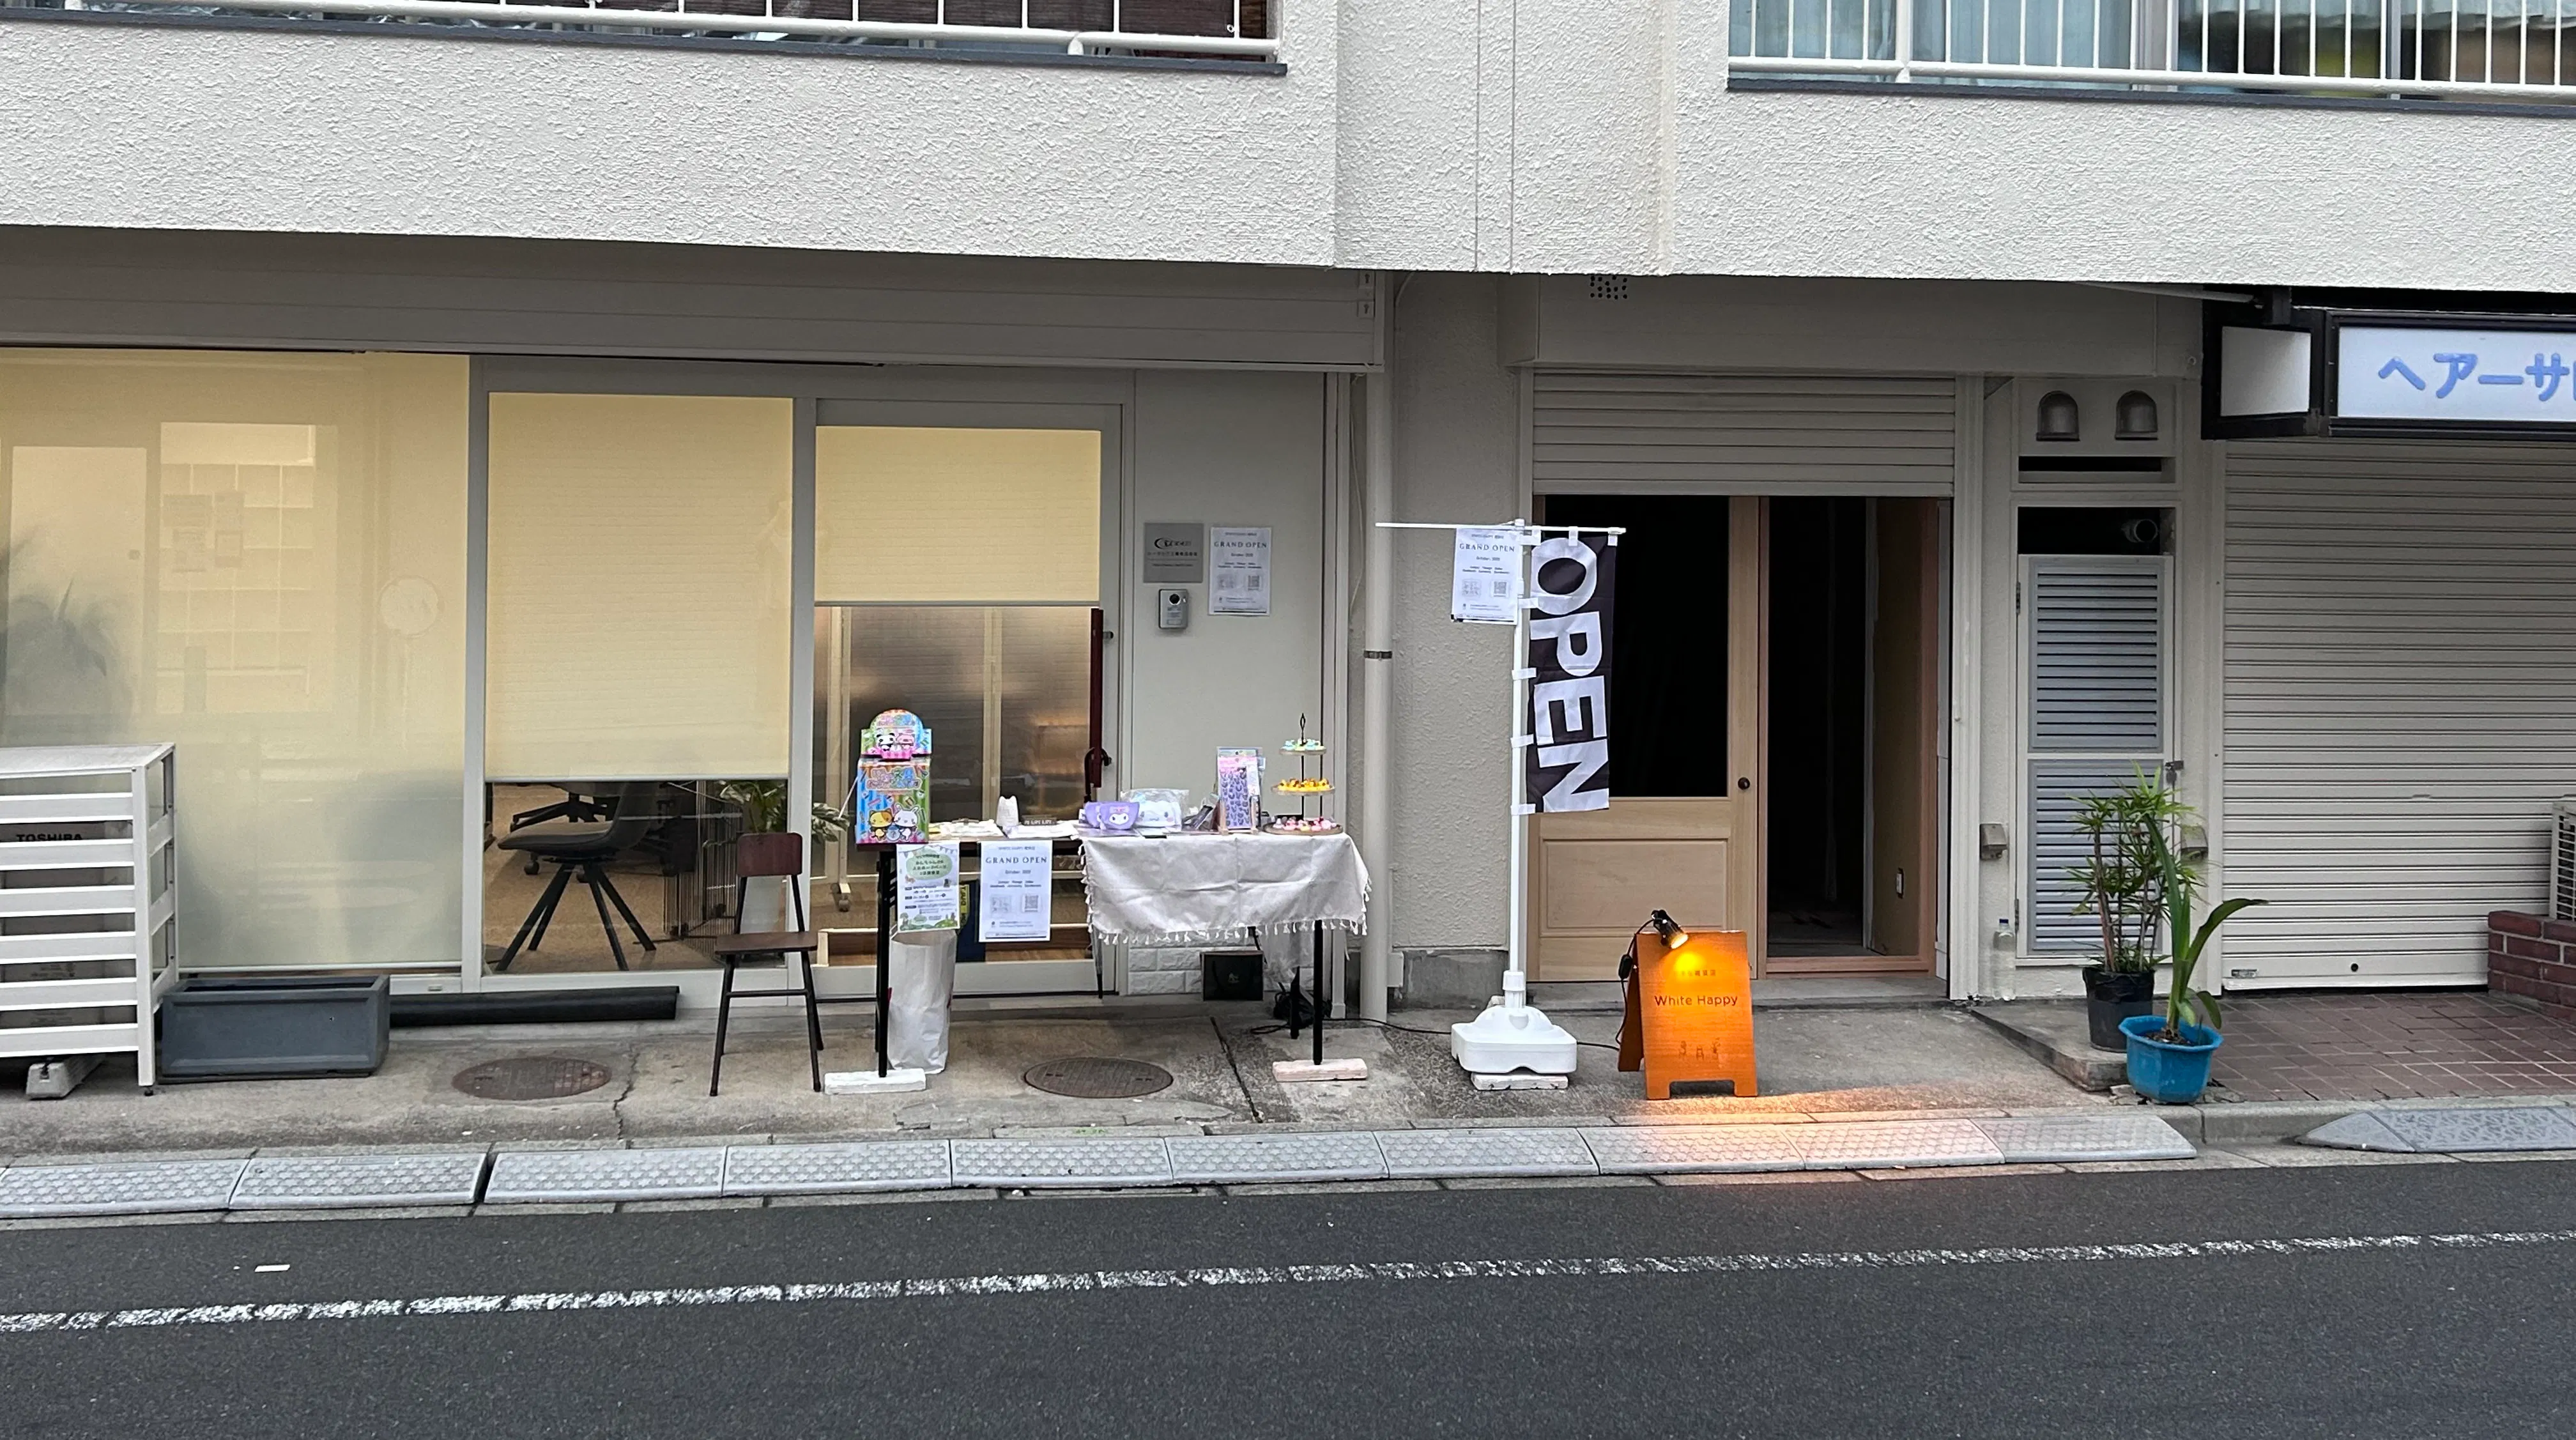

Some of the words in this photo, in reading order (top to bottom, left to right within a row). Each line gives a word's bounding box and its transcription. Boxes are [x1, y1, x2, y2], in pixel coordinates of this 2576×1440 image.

[2379, 353, 2576, 402] ヘアーサ
[1459, 543, 1489, 551] GRAND
[1529, 537, 1609, 813] OPEN
[1654, 995, 1692, 1006] White
[1696, 995, 1738, 1007] Happy
